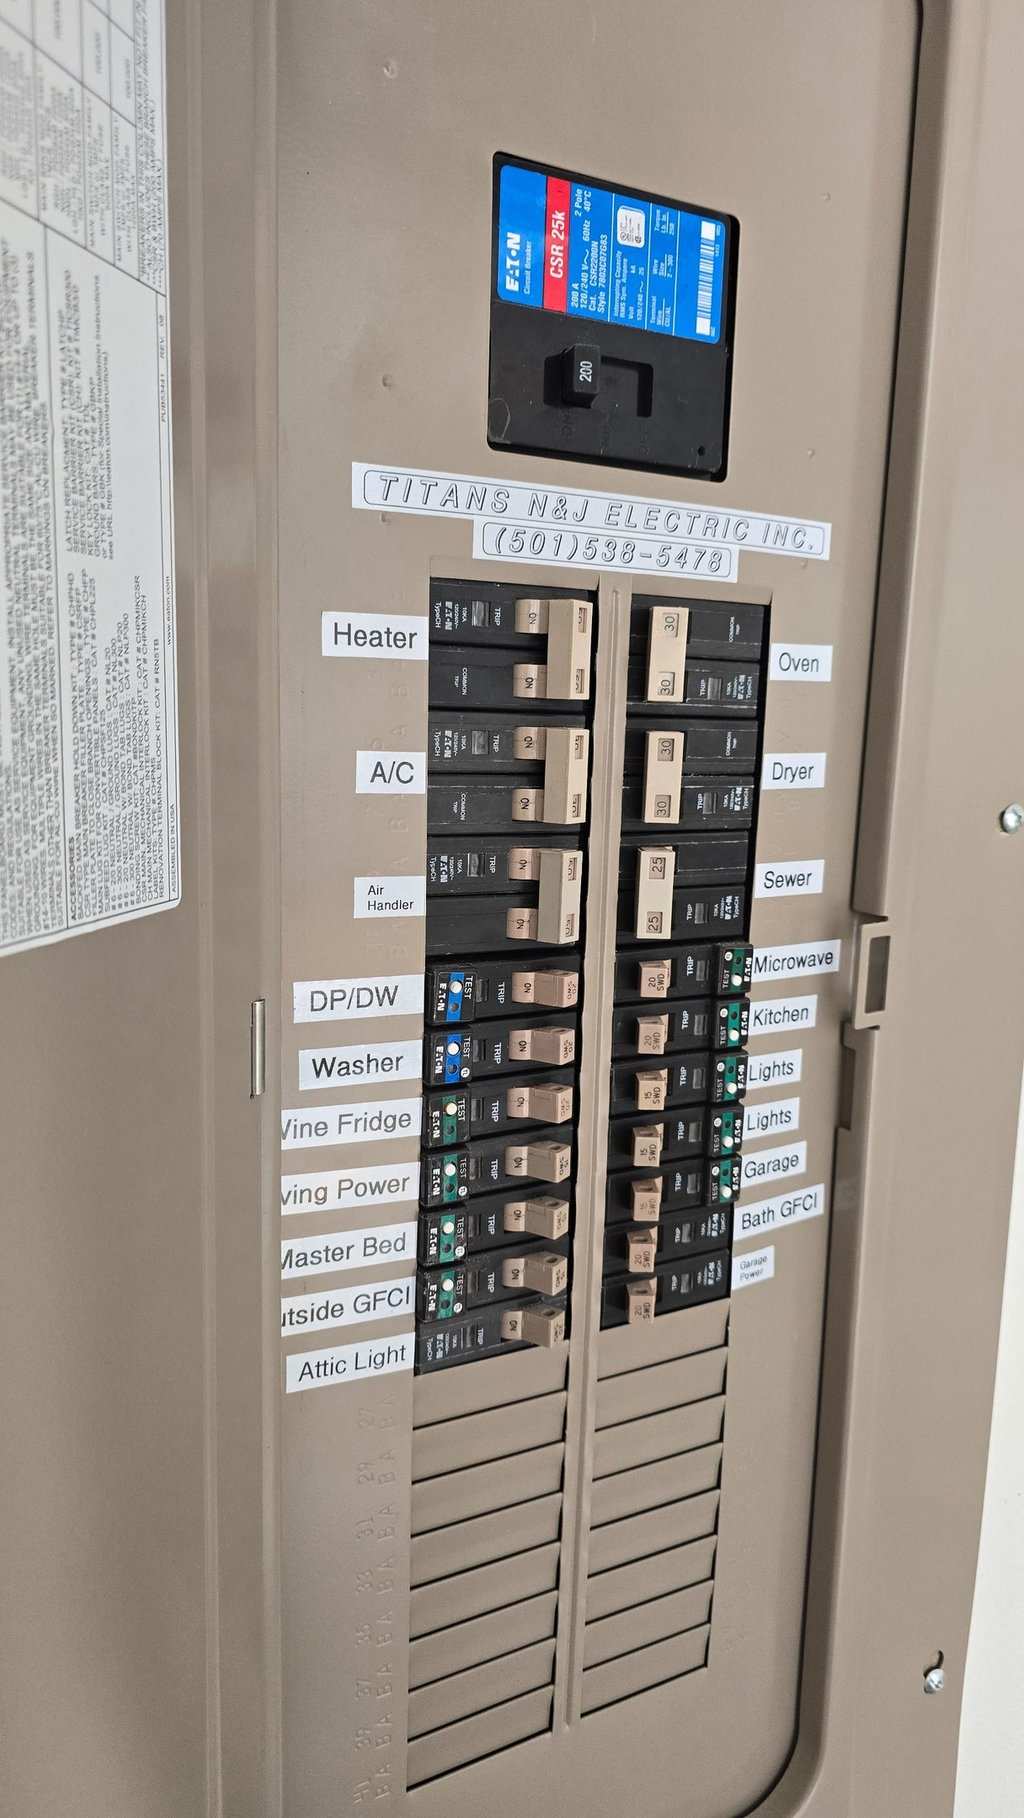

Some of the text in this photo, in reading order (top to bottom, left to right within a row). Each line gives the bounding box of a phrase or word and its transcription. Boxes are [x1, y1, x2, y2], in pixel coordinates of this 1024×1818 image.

[575, 189, 583, 208] Pole
[550, 210, 565, 278] CSR 25k
[589, 241, 598, 311] Cat. CSR2200N
[571, 283, 579, 291] A
[581, 272, 589, 308] 120/240
[571, 293, 579, 307] 200
[598, 292, 606, 312] Style
[579, 360, 593, 383] 200
[379, 474, 814, 551] TITANS N&J ELECTRIC INC.
[494, 526, 723, 573] (501)538-5478
[528, 612, 537, 625] ON
[664, 616, 675, 631] 30
[334, 622, 417, 648] Heater
[779, 652, 819, 673] Oven
[525, 676, 534, 689] ON
[661, 679, 671, 694] 30
[523, 735, 533, 749] ON
[661, 740, 672, 755] 30
[370, 761, 414, 784] A/C
[772, 762, 814, 783] Dryer
[520, 797, 529, 810] ON
[656, 801, 667, 815] 30
[171, 826, 175, 834] IN
[518, 859, 527, 870] ON
[652, 858, 662, 872] 25
[763, 870, 812, 890] Sewer
[367, 885, 384, 896] Air
[367, 900, 414, 911] Handler
[516, 918, 524, 930] ON
[648, 916, 659, 931] 25
[754, 950, 834, 974] Microwave
[464, 976, 473, 999] TEST
[523, 982, 532, 993] ON
[649, 977, 656, 987] 20
[310, 985, 399, 1012] DP/DW
[753, 1005, 809, 1027] Kitchen
[463, 1036, 471, 1058] TEST
[519, 1040, 527, 1052] ON
[644, 1035, 652, 1046] 20
[312, 1054, 404, 1079] Washer
[749, 1060, 794, 1082] Lights
[516, 1096, 525, 1108] ON
[645, 1091, 652, 1100] 15
[458, 1099, 466, 1122] TEST
[491, 1100, 499, 1122] TRIP
[338, 1110, 412, 1135] Fridge
[747, 1108, 792, 1131] Lights
[640, 1147, 648, 1156] 15
[490, 1159, 498, 1180] TRIP
[514, 1157, 522, 1168] ON
[744, 1152, 799, 1179] Garage
[337, 1176, 410, 1199] Power
[513, 1209, 521, 1220] ON
[641, 1203, 648, 1211] 15
[742, 1191, 817, 1230] Bath GFCI
[456, 1217, 464, 1239] TEST
[363, 1232, 406, 1257] Bed
[635, 1254, 642, 1264] 20
[740, 1254, 767, 1270] Garage
[511, 1268, 520, 1280] ON
[740, 1267, 764, 1281] Power
[456, 1275, 464, 1296] TEST
[353, 1286, 410, 1314] GFCI
[635, 1304, 642, 1316] 20
[510, 1320, 518, 1331] ON
[298, 1344, 406, 1382] Attic Light
